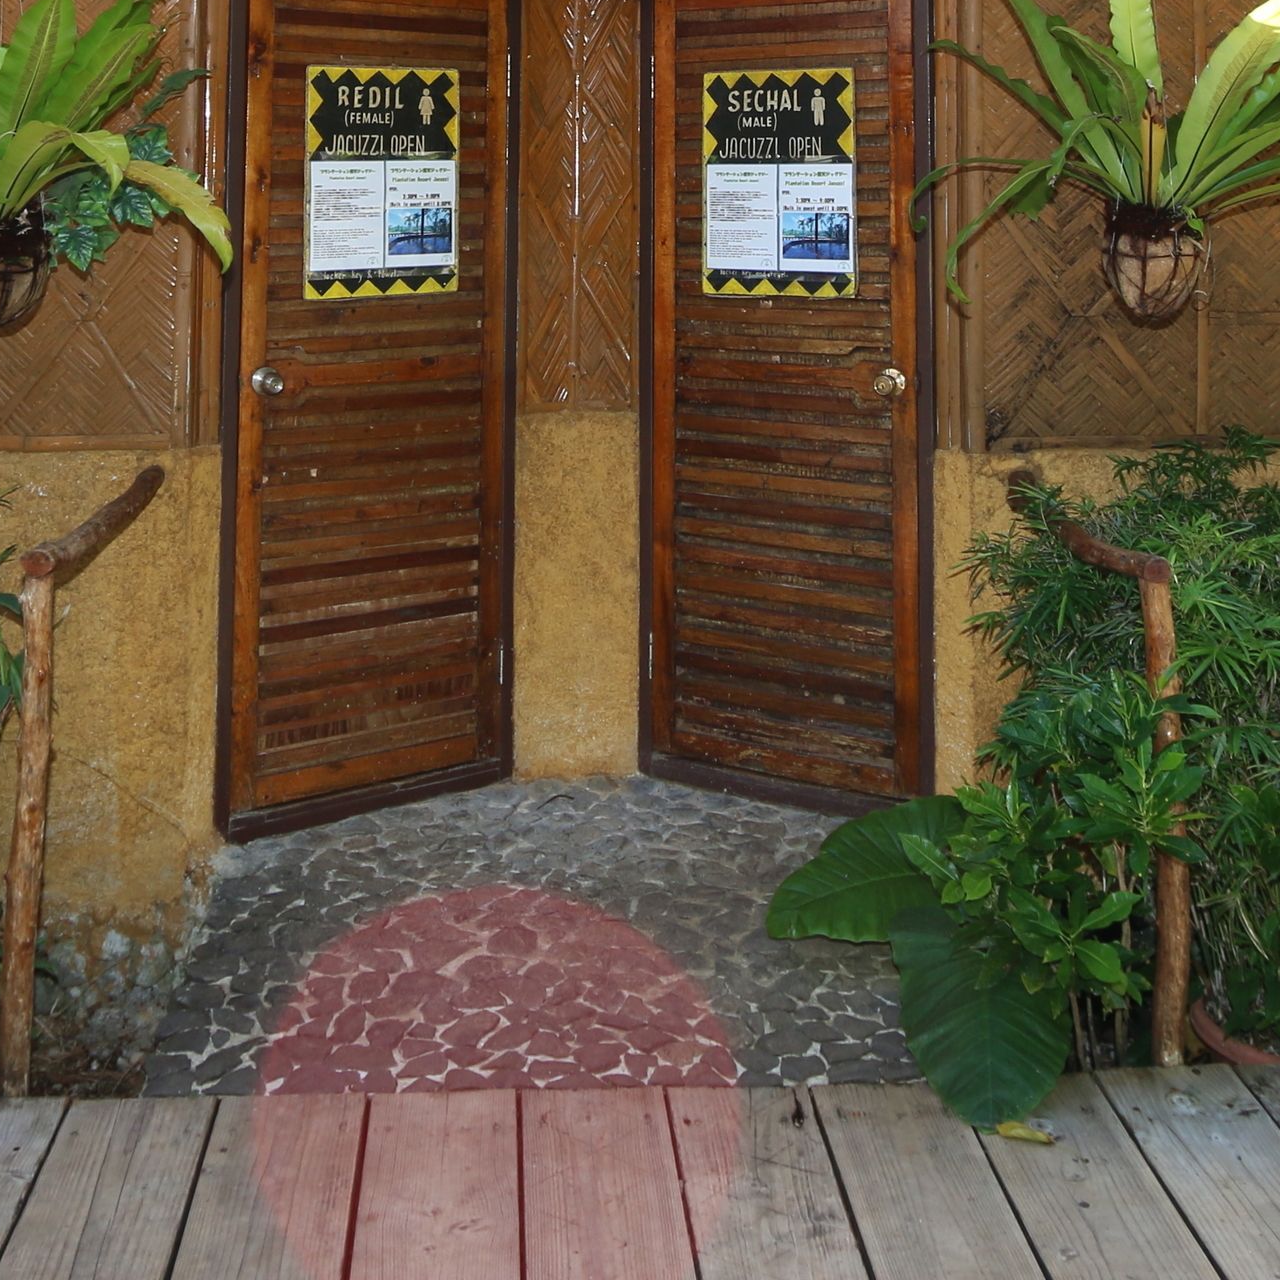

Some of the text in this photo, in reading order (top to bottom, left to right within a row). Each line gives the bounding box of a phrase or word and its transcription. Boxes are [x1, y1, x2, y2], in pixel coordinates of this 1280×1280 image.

[337, 85, 405, 110] REDIL
[727, 88, 802, 113] SECHAL
[344, 109, 395, 128] (FEMALE)
[737, 112, 778, 132] (MALE)
[325, 134, 425, 156] JACUZZI OPEN
[719, 136, 822, 159] JACUZZI OPEN
